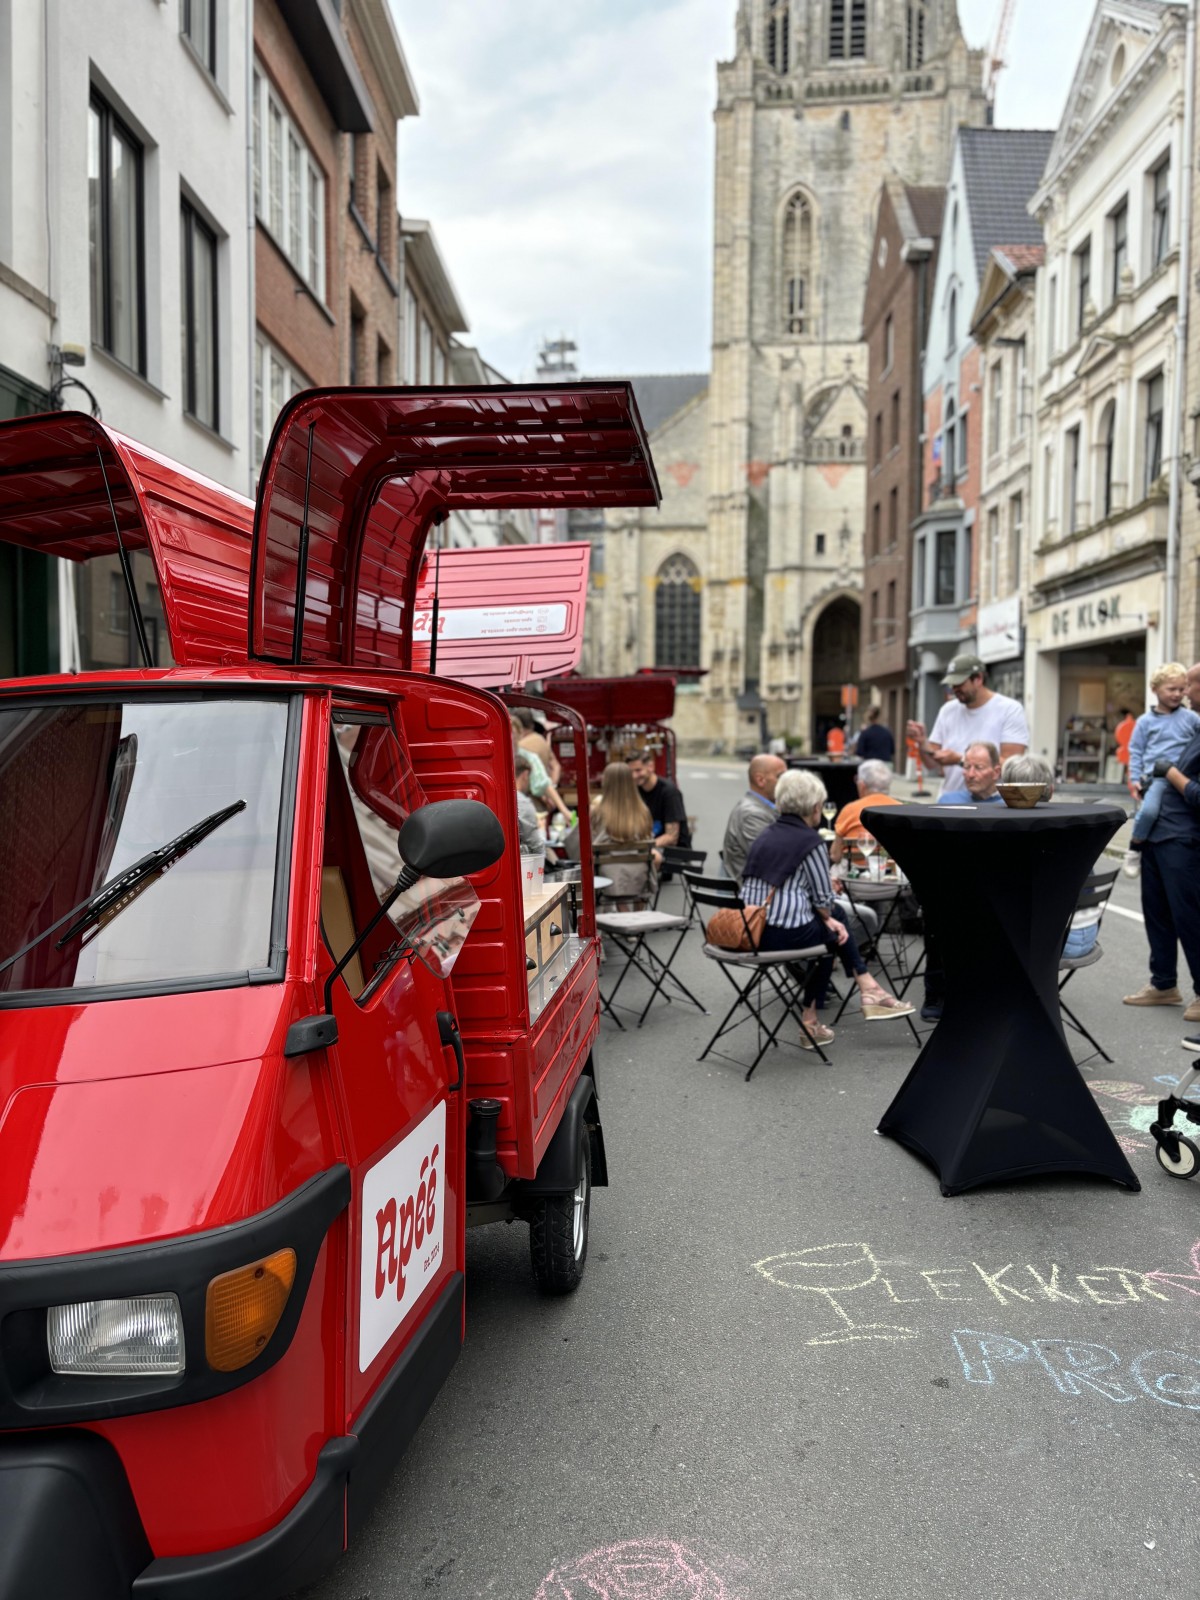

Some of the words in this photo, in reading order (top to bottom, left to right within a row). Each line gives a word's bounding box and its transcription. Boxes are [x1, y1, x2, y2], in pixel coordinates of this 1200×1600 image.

[1052, 609, 1069, 636] DE
[1077, 595, 1121, 628] KLOK
[880, 1261, 1169, 1306] LEKKER
